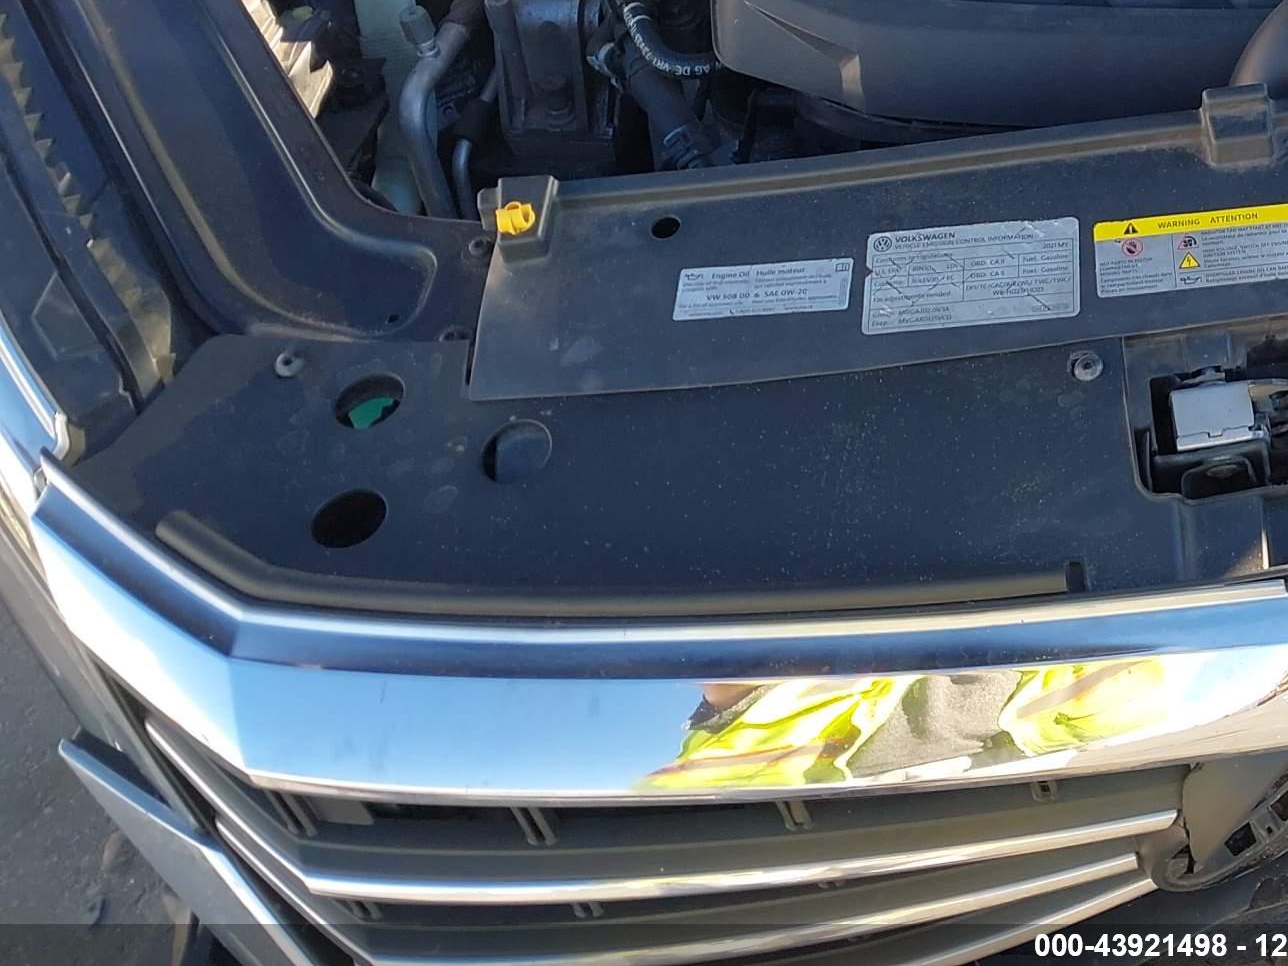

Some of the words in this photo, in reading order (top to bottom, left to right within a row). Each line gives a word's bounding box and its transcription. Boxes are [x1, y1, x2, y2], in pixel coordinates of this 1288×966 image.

[1157, 217, 1200, 229] WARNING
[1209, 211, 1258, 224] ATTENTION
[894, 231, 955, 243] VOLKSWAGEN
[955, 236, 985, 245] CONTROL
[987, 232, 1033, 242] INFORMATION
[1040, 252, 1068, 262] Gasoline
[711, 270, 737, 280] Engine
[738, 269, 750, 277] Oil
[756, 268, 776, 276] Huile
[776, 266, 805, 275] moteur
[1040, 264, 1068, 273] Gasoline
[705, 293, 721, 301] VW
[738, 291, 751, 299] 00
[763, 289, 778, 297] SAE
